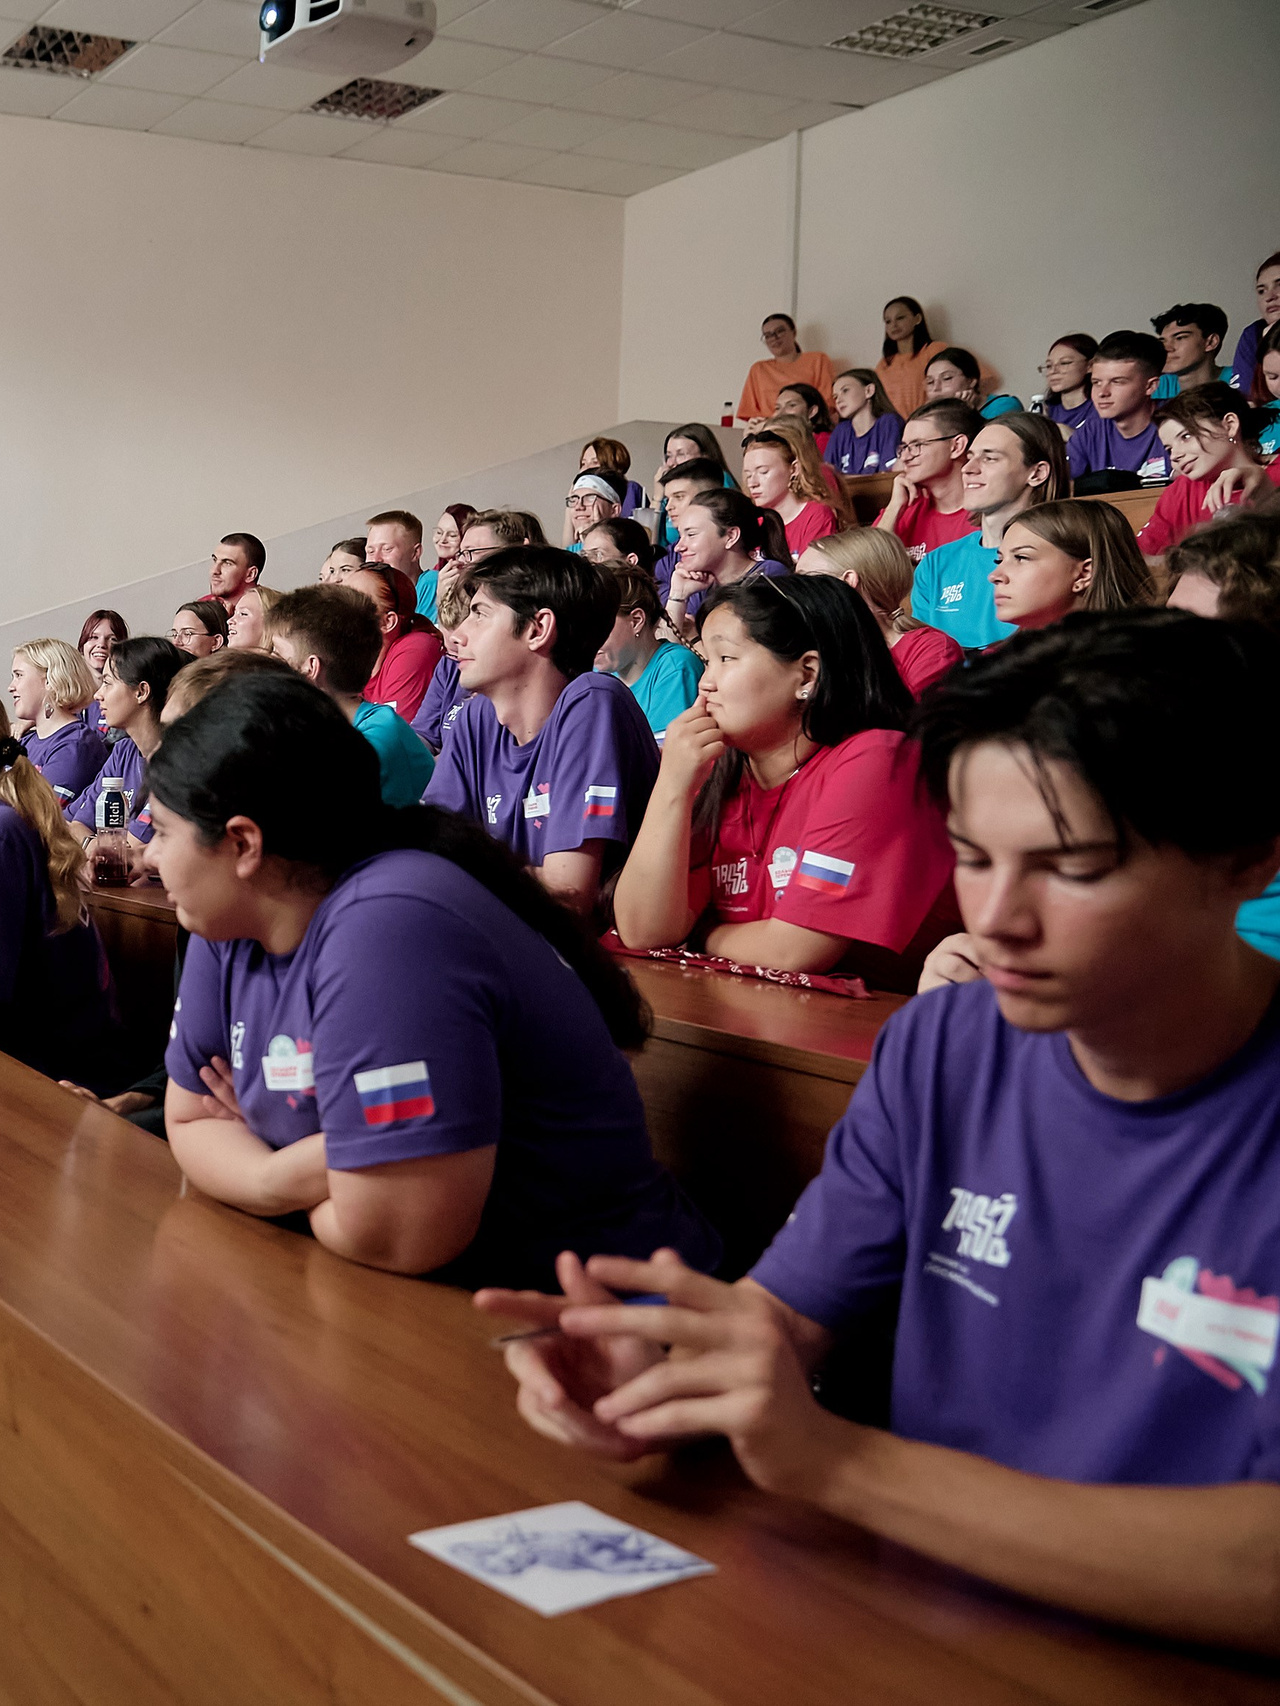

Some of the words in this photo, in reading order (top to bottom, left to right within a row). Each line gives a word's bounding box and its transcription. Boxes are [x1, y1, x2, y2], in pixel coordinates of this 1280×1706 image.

[109, 802, 120, 825] Rich
[712, 857, 748, 888] ТВОЙ
[941, 1187, 1018, 1238] ТВОЙ
